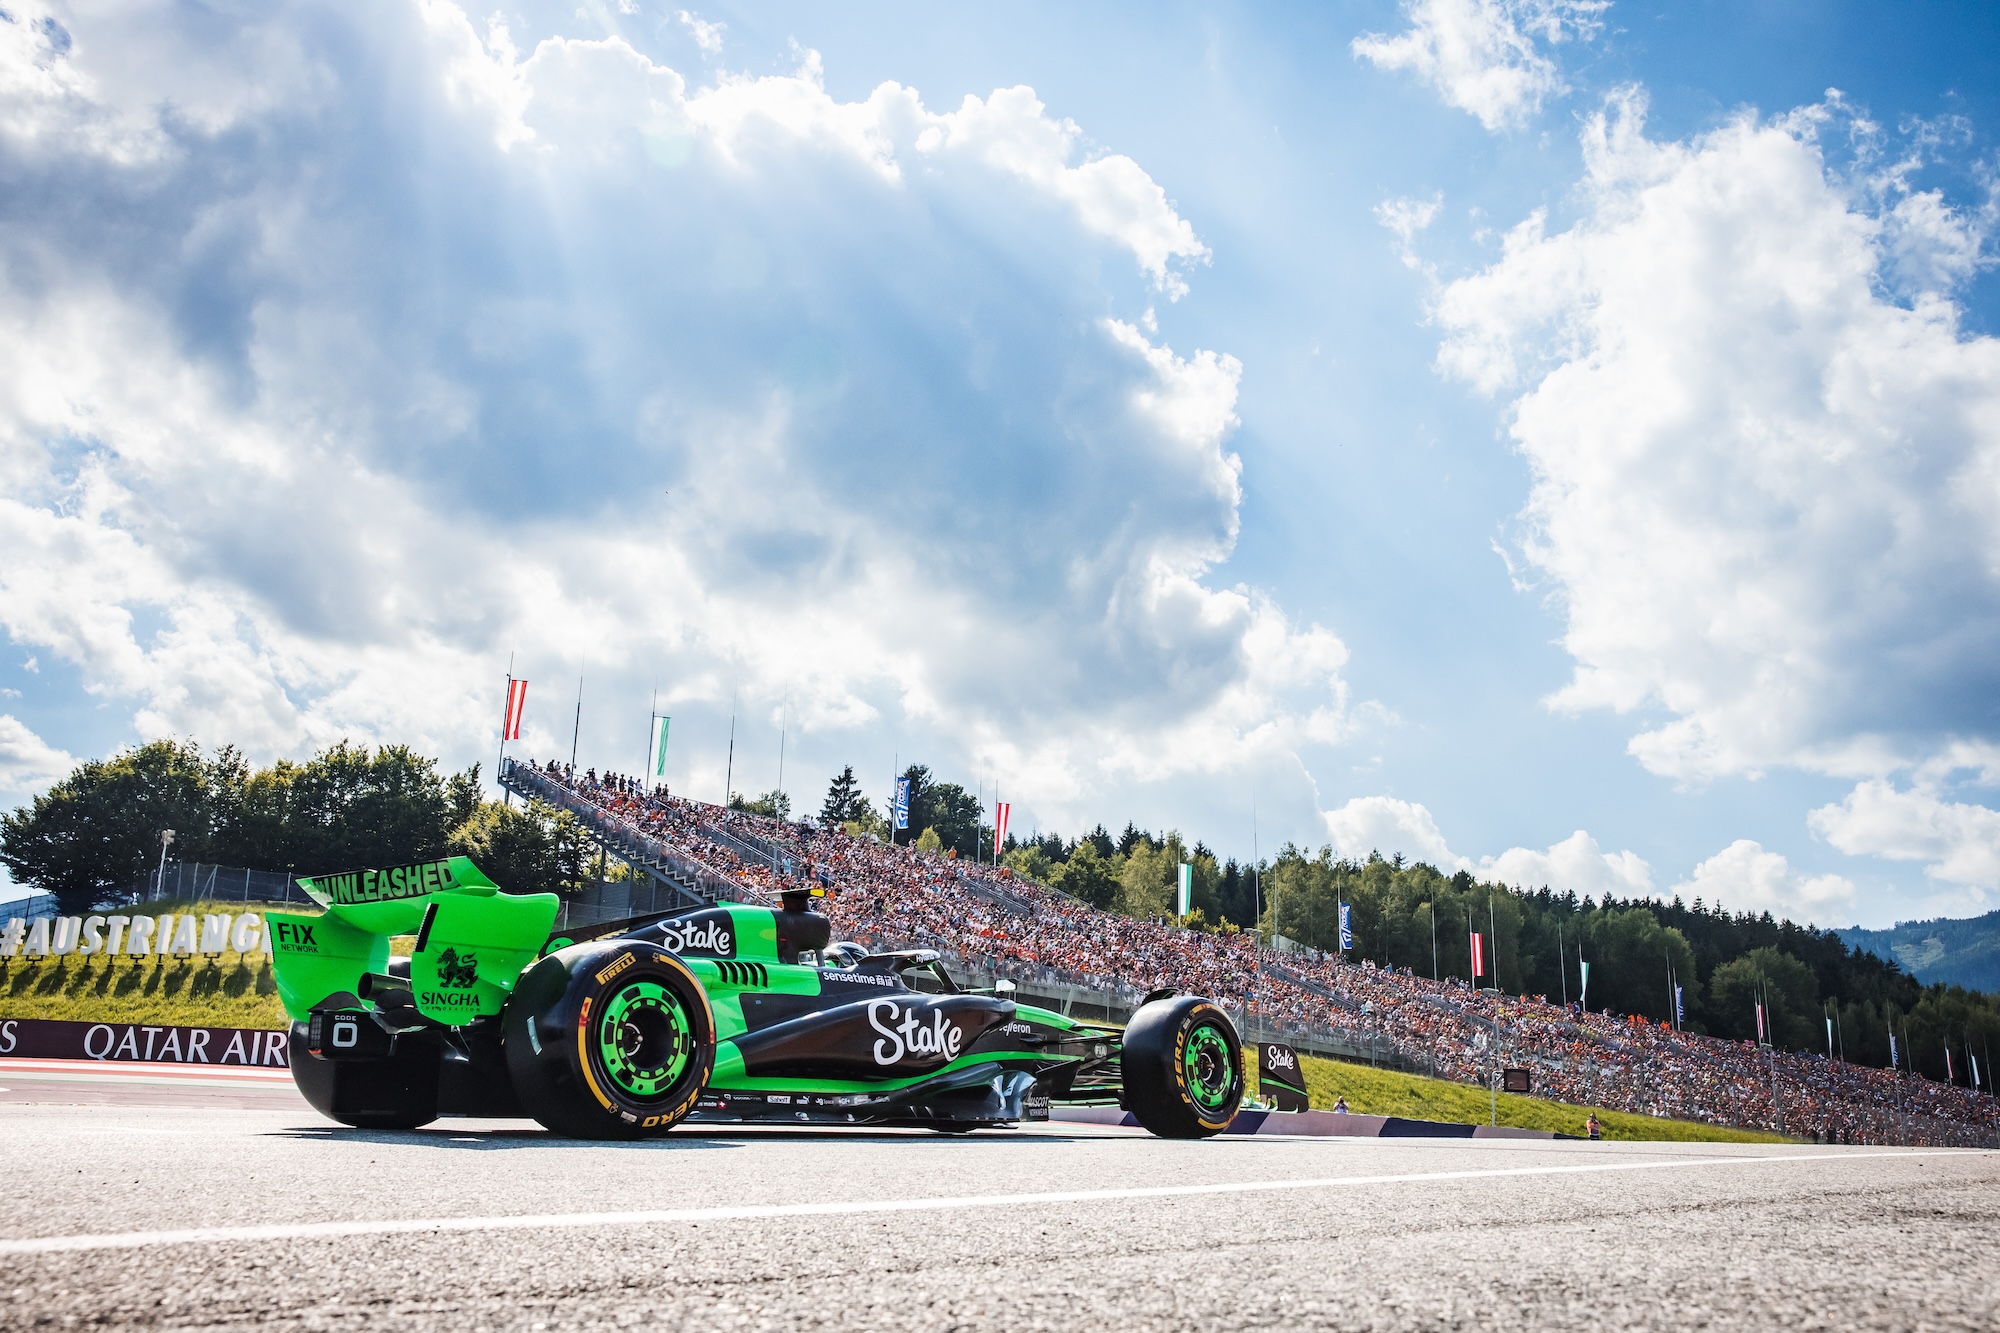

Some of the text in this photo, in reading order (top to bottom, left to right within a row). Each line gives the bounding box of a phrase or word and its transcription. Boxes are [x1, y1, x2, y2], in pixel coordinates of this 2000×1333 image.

[277, 922, 317, 945] FIX
[281, 943, 319, 954] NETWORK
[657, 919, 730, 956] Stake
[595, 952, 637, 985] PIRELLI
[823, 971, 876, 985] sensetime
[421, 992, 481, 1007] SINGHA
[84, 1024, 210, 1063] QATAR
[868, 1000, 962, 1065] Stake
[1174, 1031, 1186, 1088] ZERO
[1268, 1045, 1294, 1070] Stake
[641, 1087, 699, 1128] ZERO
